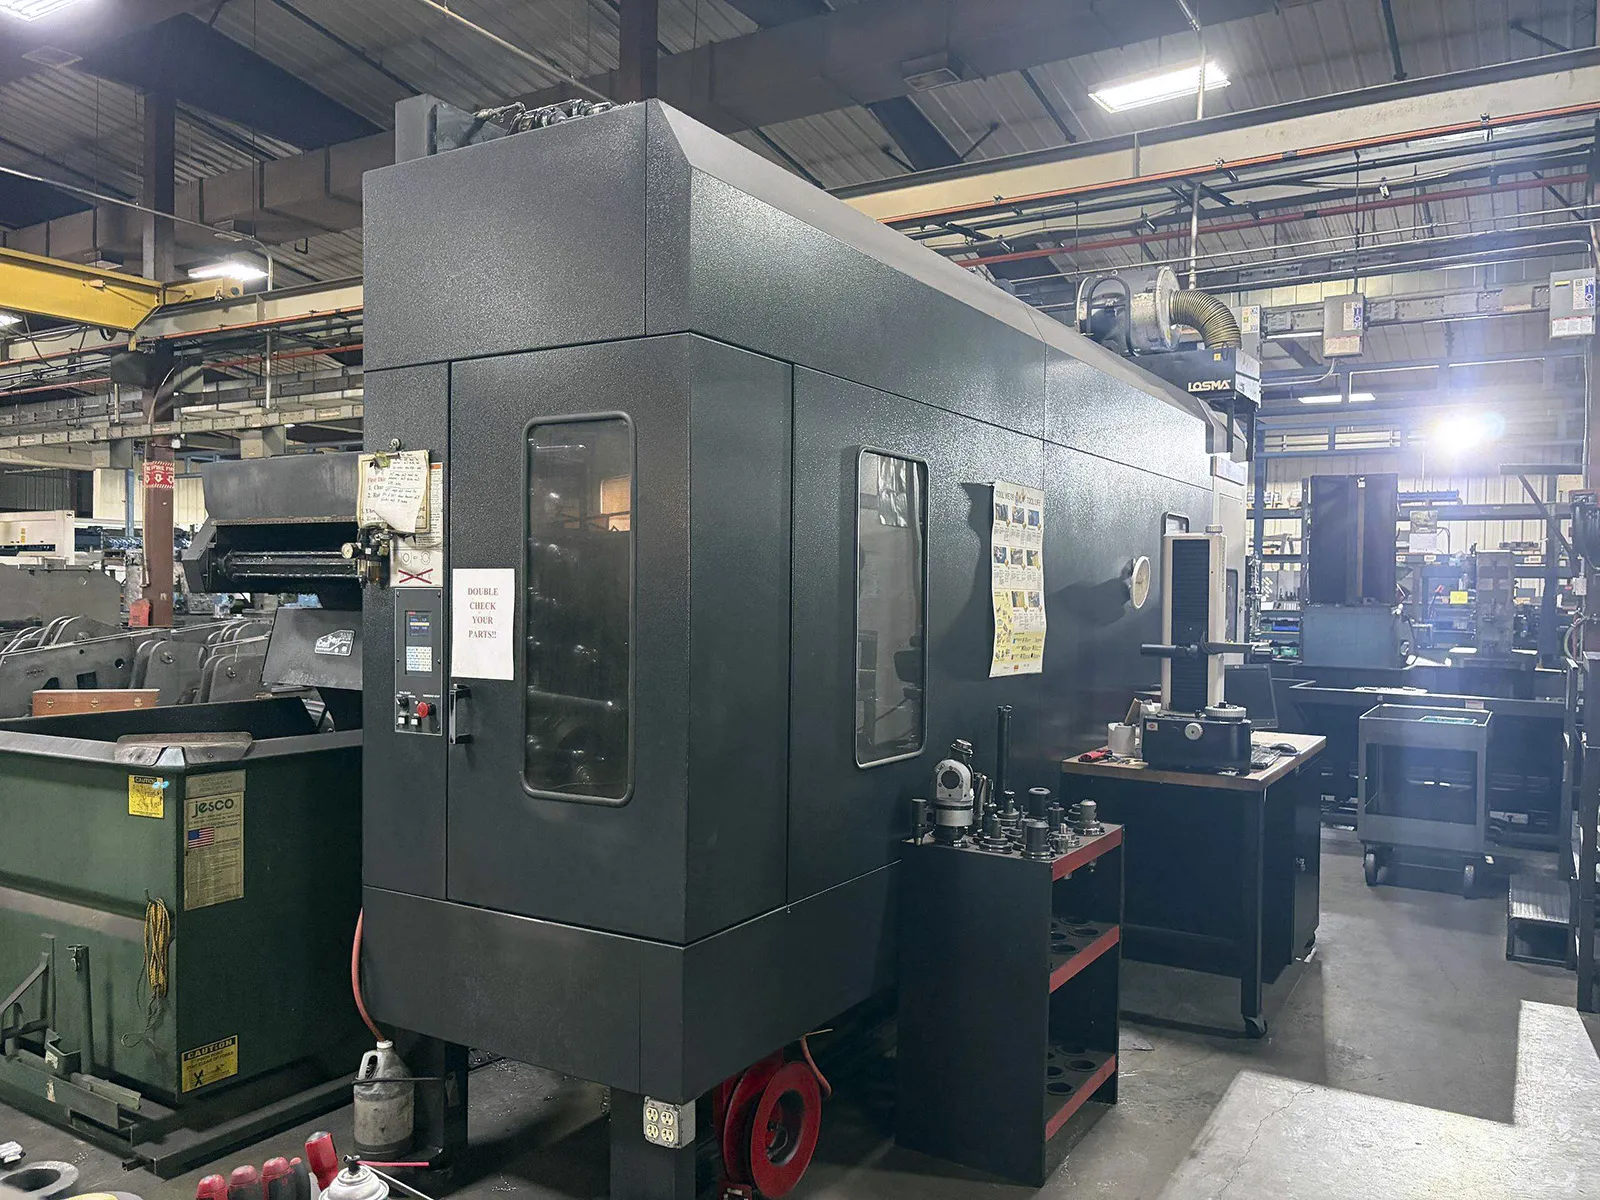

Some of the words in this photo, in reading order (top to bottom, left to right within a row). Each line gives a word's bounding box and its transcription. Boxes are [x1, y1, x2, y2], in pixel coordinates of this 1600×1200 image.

[1188, 380, 1231, 392] LOSMA
[467, 587, 499, 596] DOUBLE
[469, 601, 496, 610] CHECK
[472, 615, 493, 624] YOUR
[468, 630, 497, 639] PARTS!!
[191, 798, 234, 819] jesco
[187, 1039, 233, 1059] CAUTION
